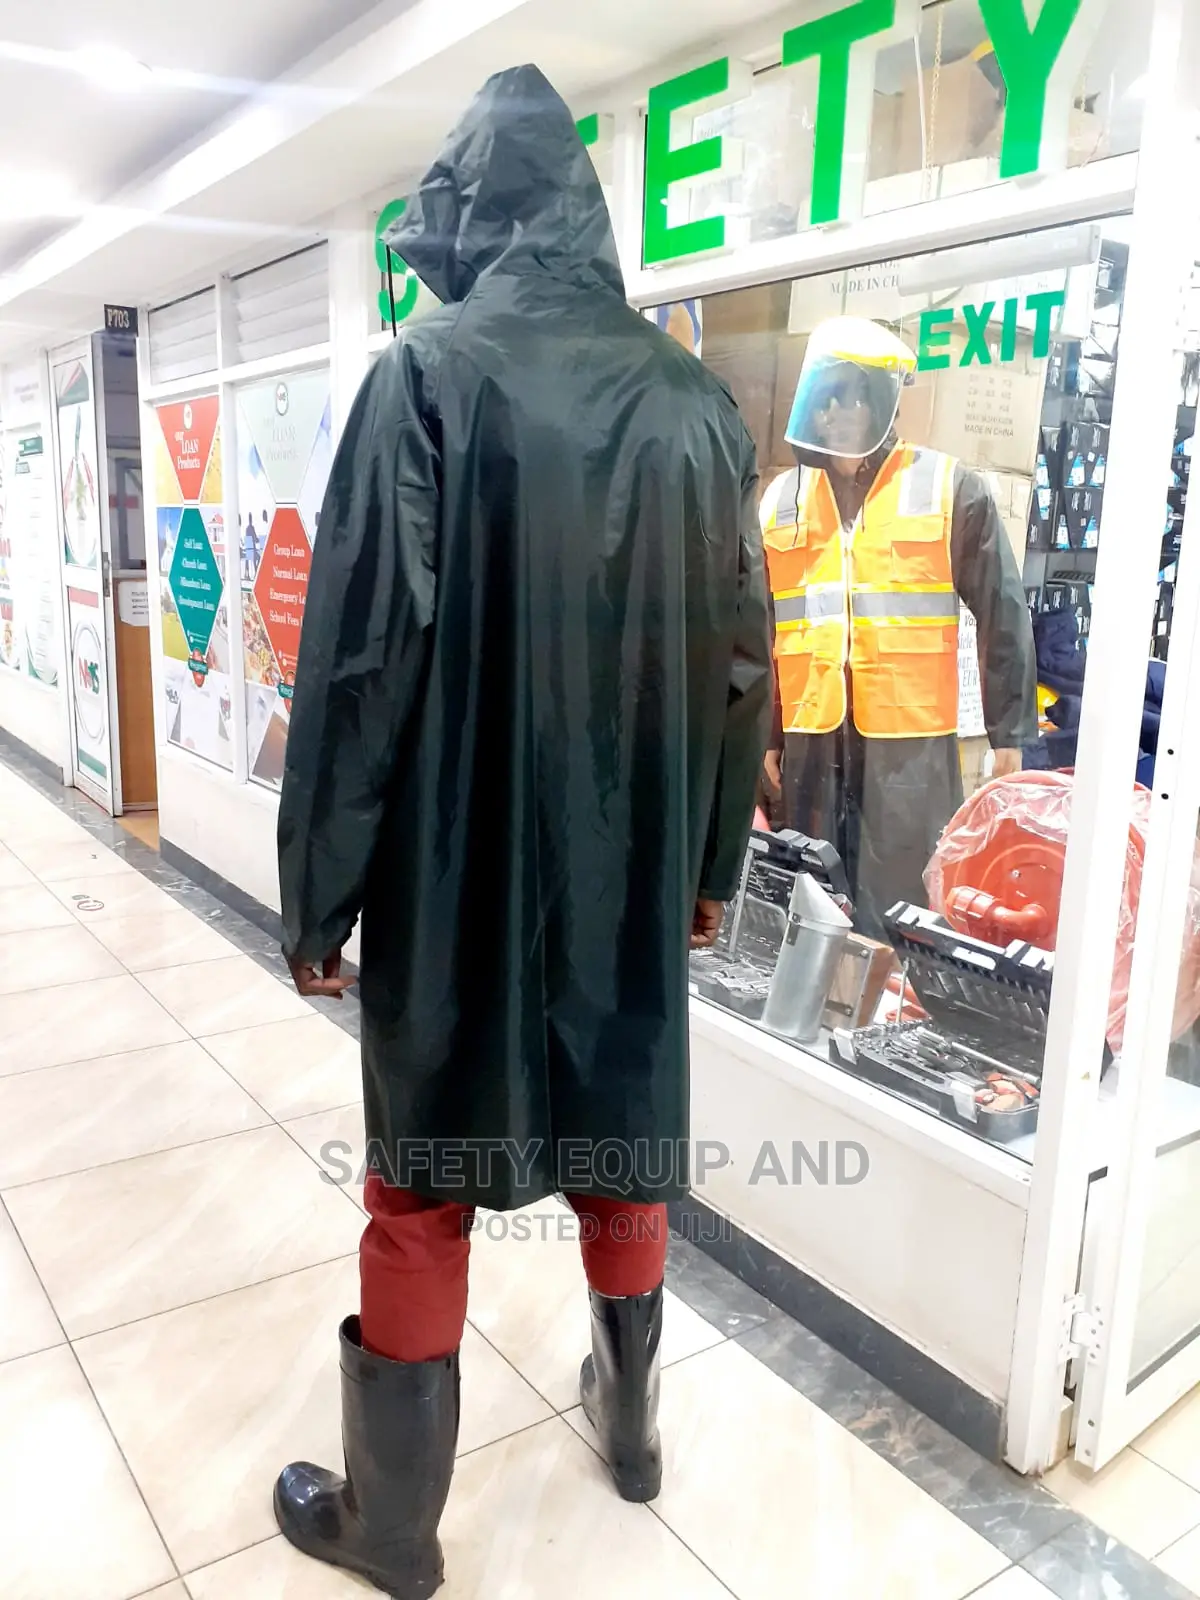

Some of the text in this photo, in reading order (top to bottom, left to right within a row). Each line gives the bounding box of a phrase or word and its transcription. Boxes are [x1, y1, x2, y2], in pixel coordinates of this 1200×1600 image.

[867, 277, 880, 290] IN
[917, 290, 1067, 372] EXIT
[964, 423, 1014, 437] MADE IN CHINA
[182, 438, 199, 454] LOAN
[177, 455, 200, 469] Products
[273, 543, 305, 559] Group Loan
[272, 564, 308, 582] Normal Loan
[269, 587, 298, 606] Emergency
[269, 609, 287, 625] School
[286, 611, 300, 627] Fees
